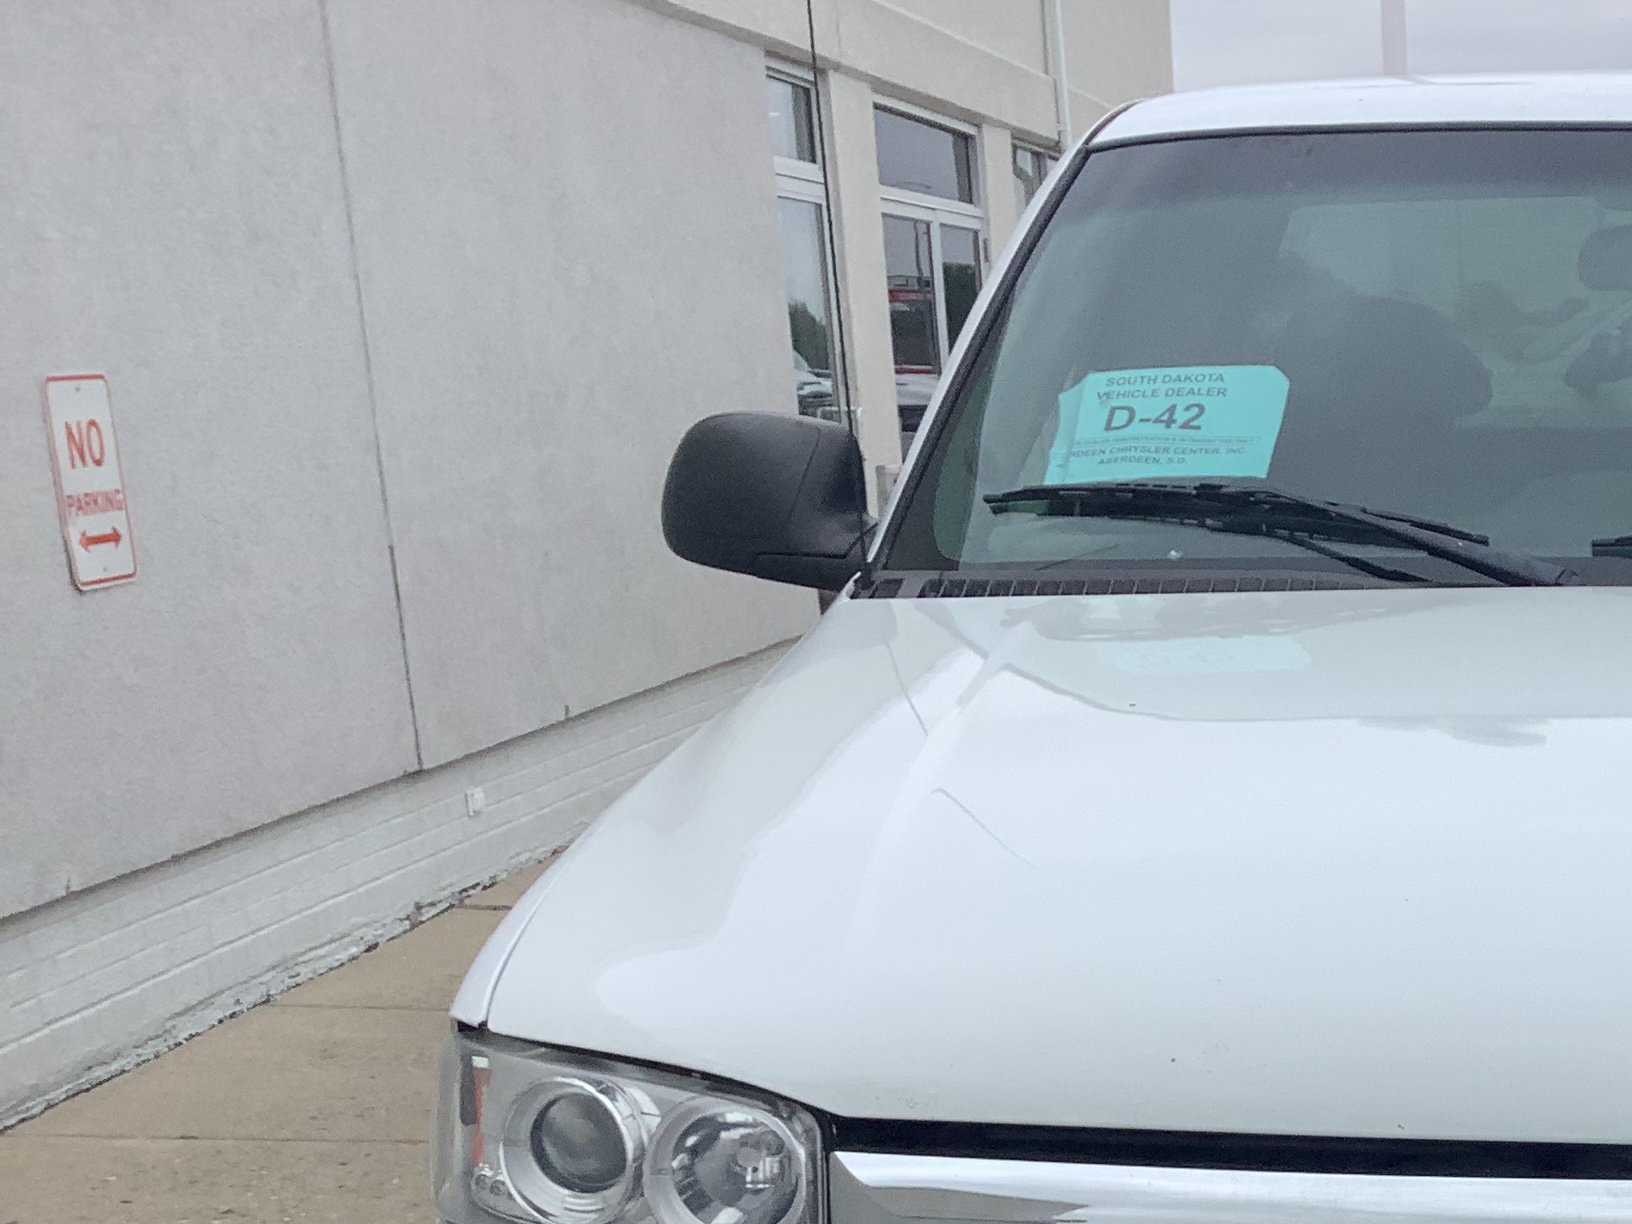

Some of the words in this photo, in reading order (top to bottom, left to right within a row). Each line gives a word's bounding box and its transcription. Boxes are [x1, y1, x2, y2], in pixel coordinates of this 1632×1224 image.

[1105, 375, 1157, 387] SOUTH
[1161, 373, 1225, 384] DAKOTA
[1097, 388, 1160, 400] VEHICLE
[1164, 387, 1227, 398] DEALER
[1104, 403, 1206, 431] D-42
[65, 418, 105, 469] NO
[1109, 445, 1170, 455] CHRYSLER
